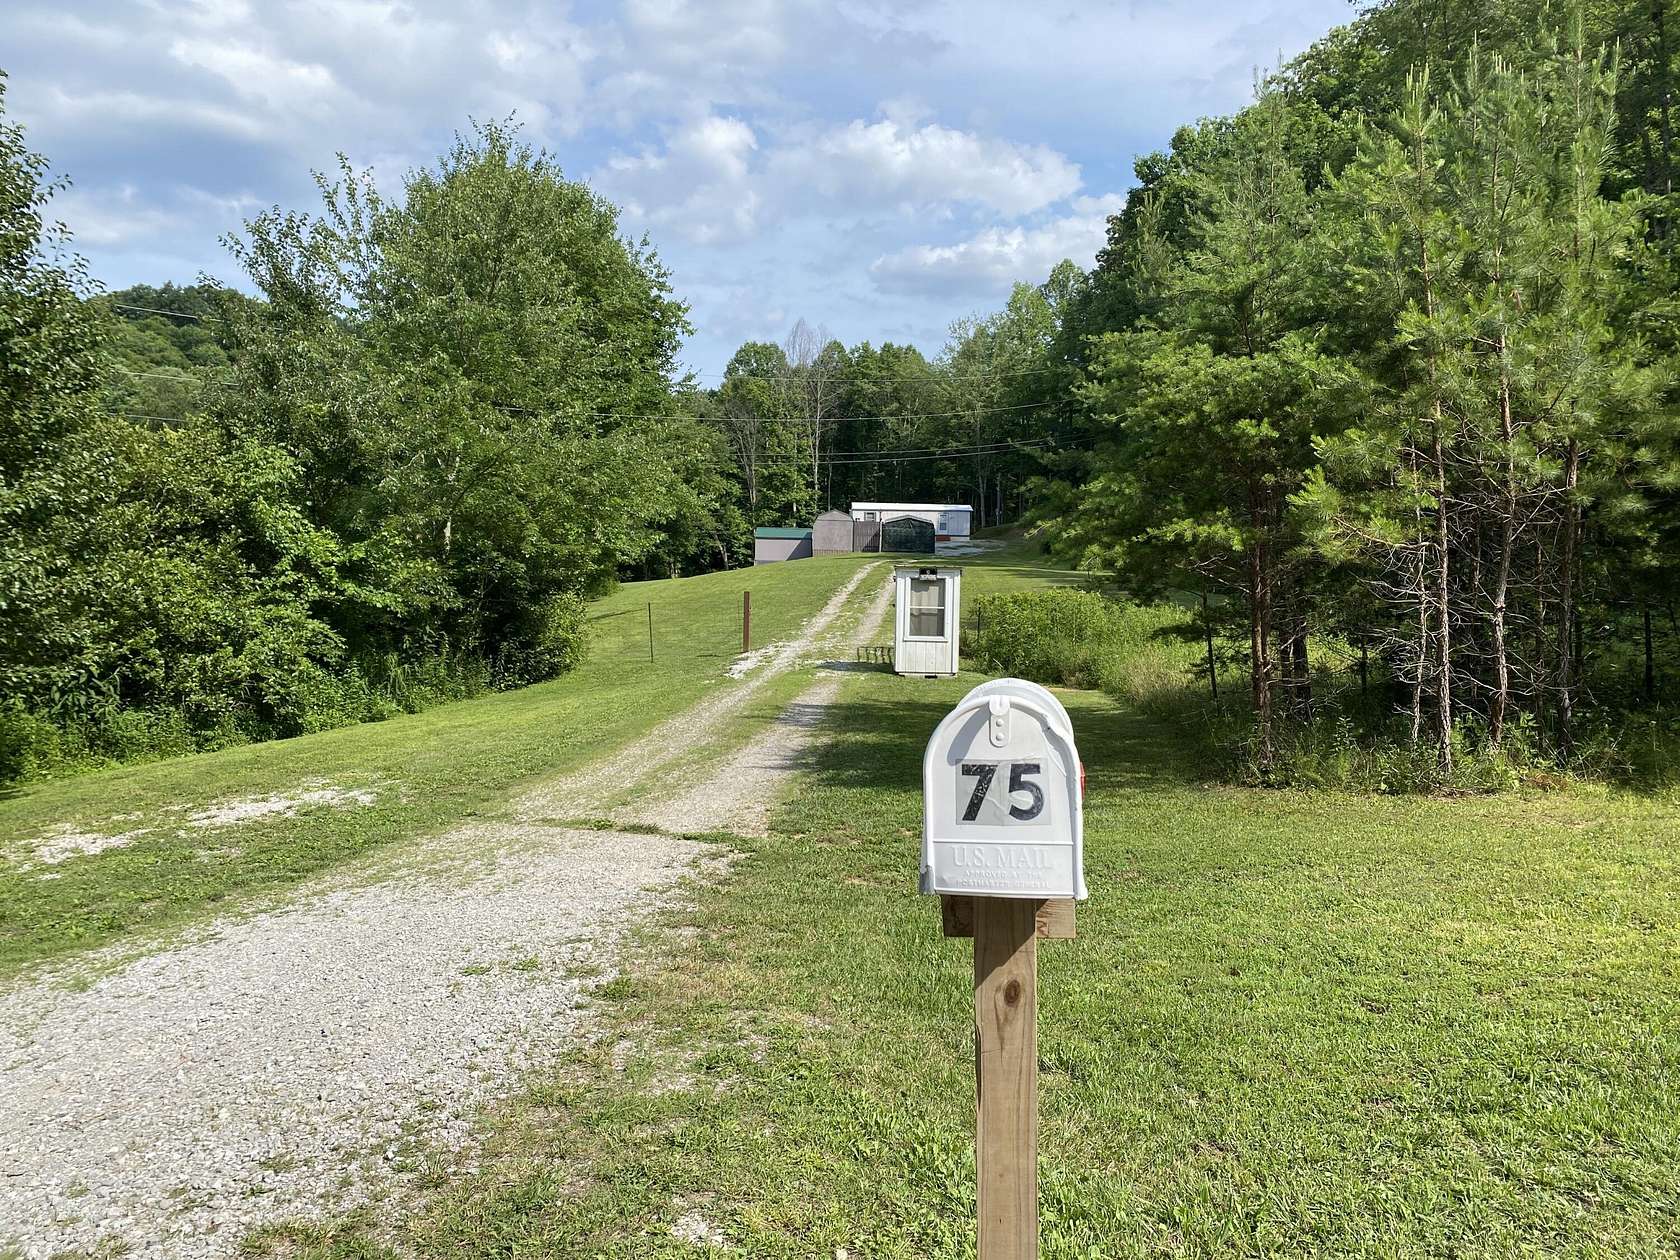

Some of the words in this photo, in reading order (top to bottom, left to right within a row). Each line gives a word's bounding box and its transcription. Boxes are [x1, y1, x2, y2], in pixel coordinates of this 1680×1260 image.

[961, 763, 1044, 822] 75
[952, 845, 991, 868] U.S.
[996, 847, 1053, 870] MAIL
